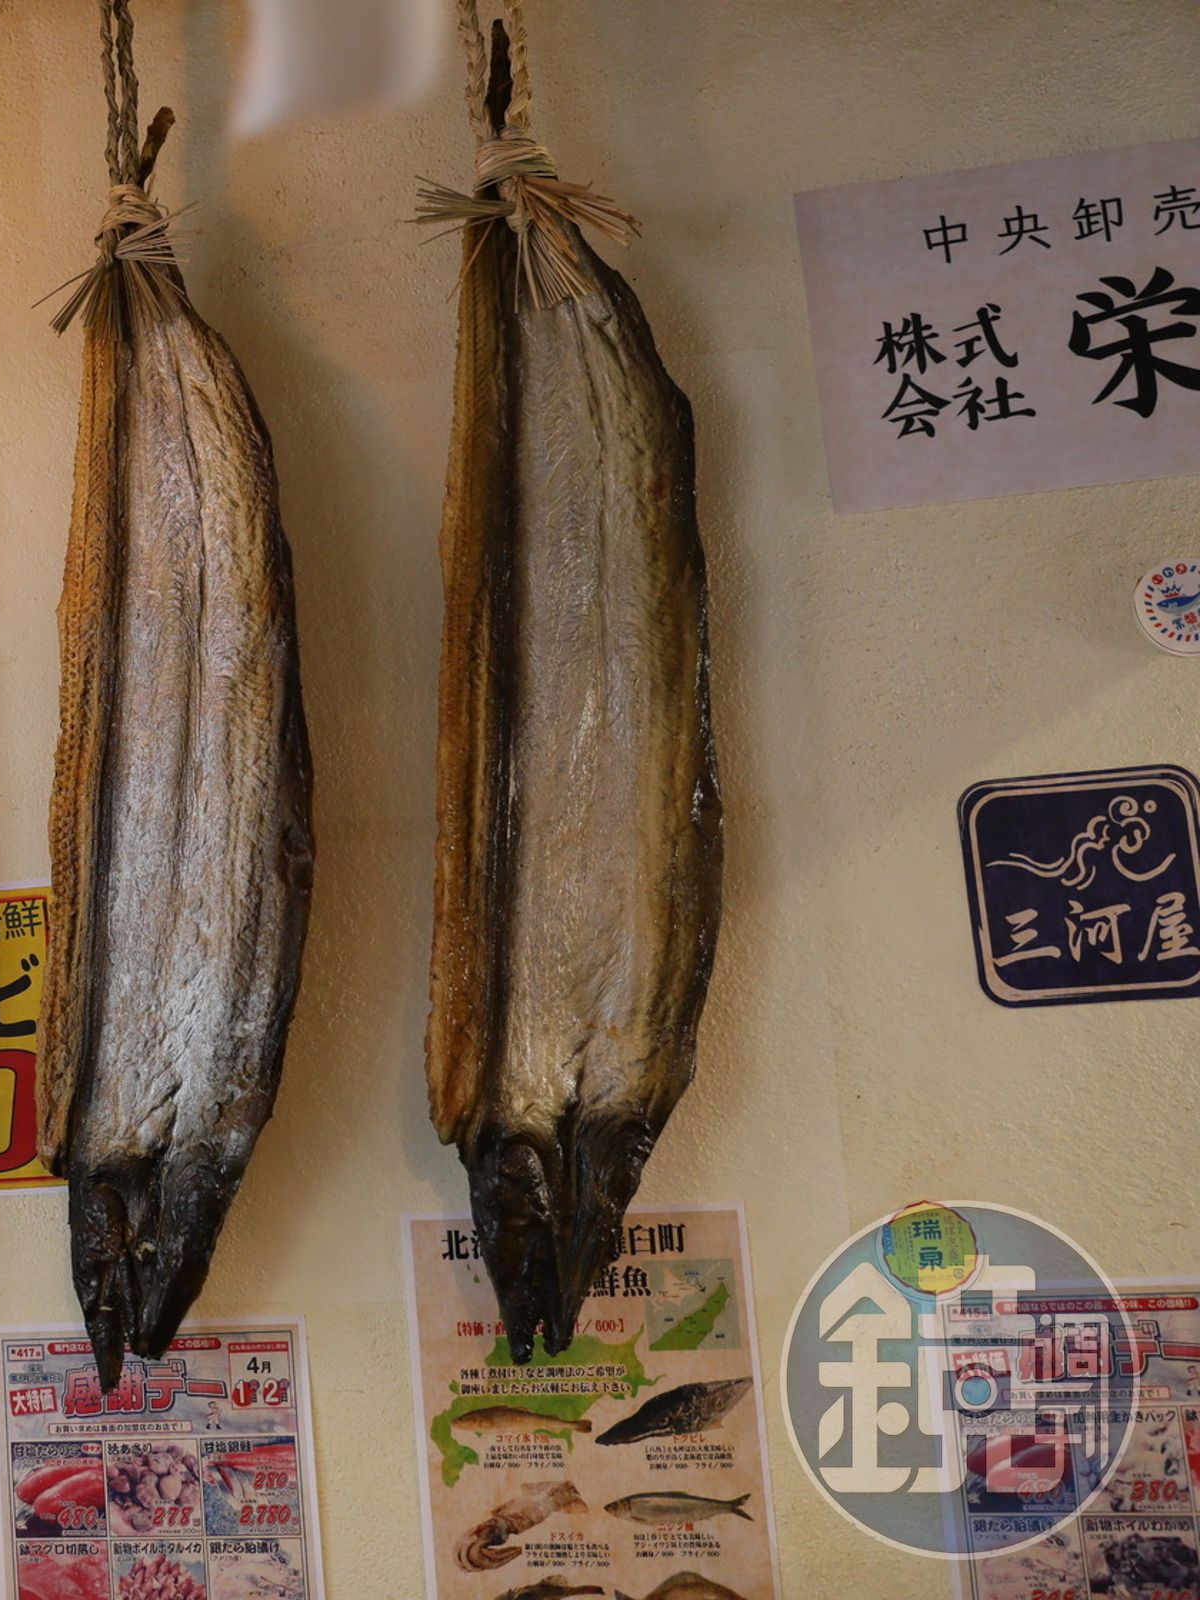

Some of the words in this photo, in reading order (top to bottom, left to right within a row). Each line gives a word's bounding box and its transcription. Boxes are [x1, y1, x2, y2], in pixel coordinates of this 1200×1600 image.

[923, 185, 1200, 264] 中央卸売
[872, 303, 1018, 375] 株式
[1068, 266, 1200, 419] 栄
[881, 373, 1036, 440] 会社
[993, 891, 1200, 969] 三河屋
[12, 1388, 55, 1414] 大特価
[246, 1356, 272, 1374] 4月
